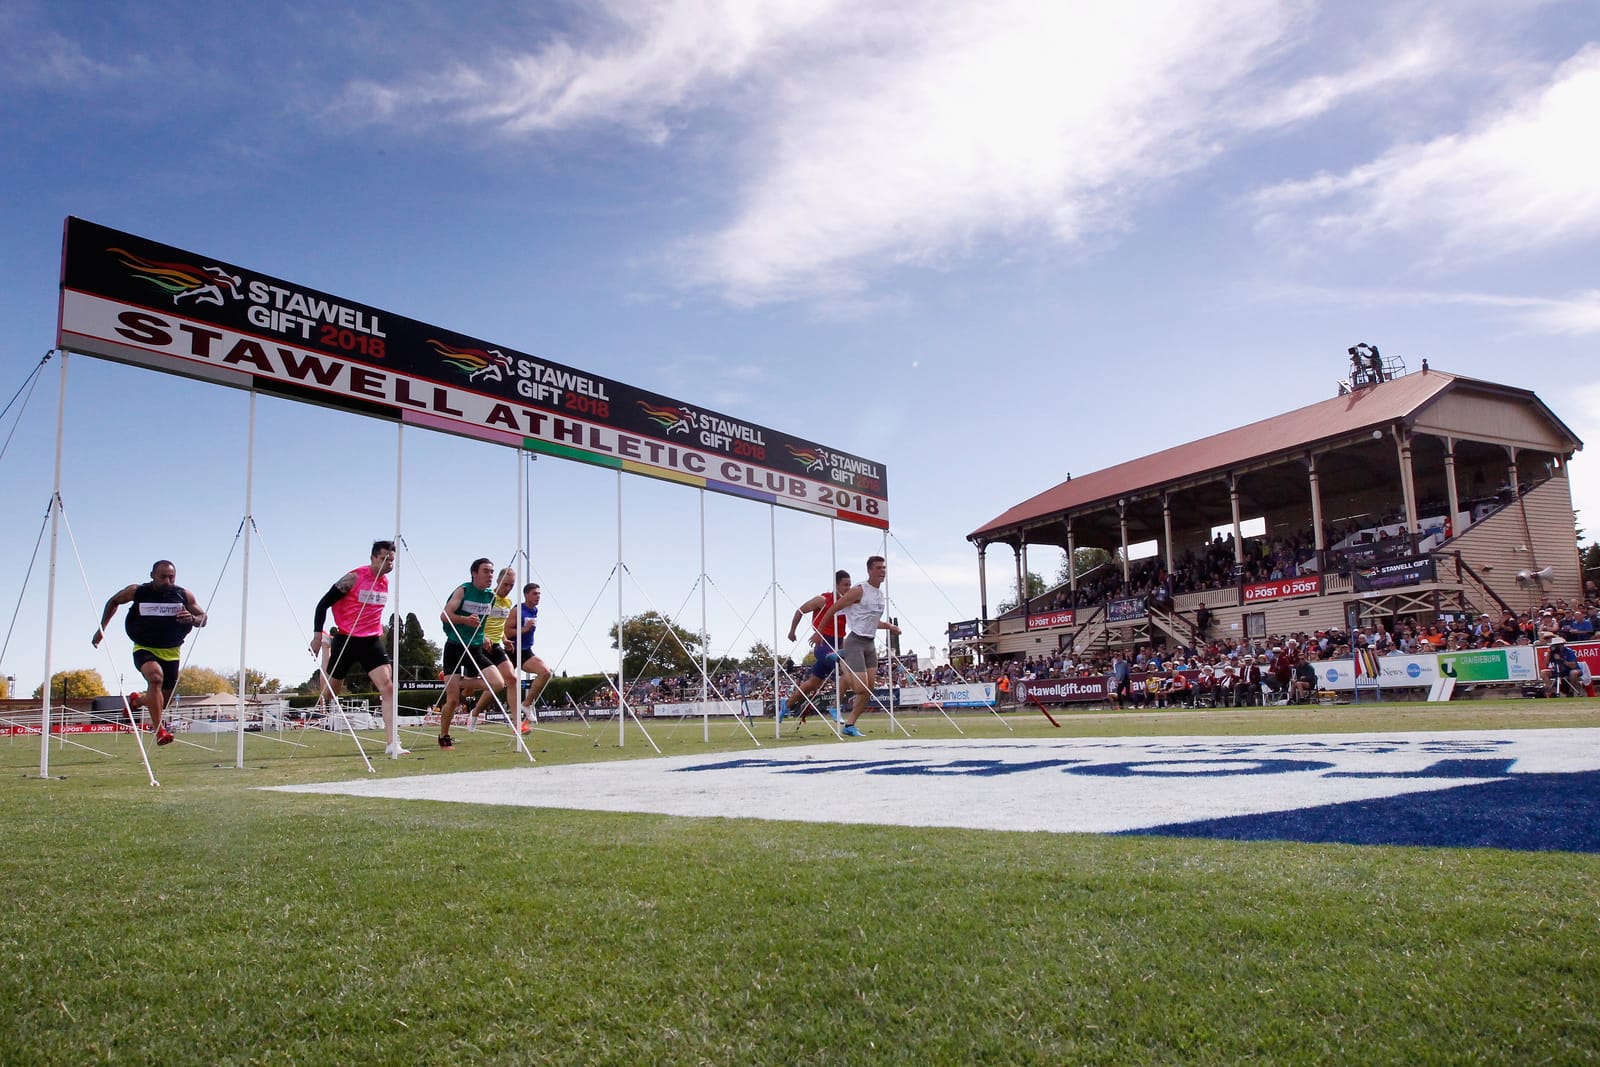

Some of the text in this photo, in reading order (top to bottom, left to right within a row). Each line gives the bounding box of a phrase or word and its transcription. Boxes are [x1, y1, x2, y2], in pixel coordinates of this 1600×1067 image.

[249, 280, 386, 338] STAWELL
[247, 308, 386, 358] GIFT 2018
[517, 359, 609, 401] STAWELL
[113, 310, 880, 515] STAWELL ATHLETIC CLUB 2018
[516, 380, 609, 418] GIFT 2018
[699, 414, 766, 446] STAWELL
[699, 430, 766, 461] GIFT 2018
[830, 453, 880, 479] STAWELL
[830, 467, 855, 486] GIFT
[1381, 559, 1429, 574] STAWELL GIFT
[1255, 581, 1317, 598] POST POST
[1035, 615, 1072, 626] POST POST
[1028, 682, 1102, 697] stawellgift.com
